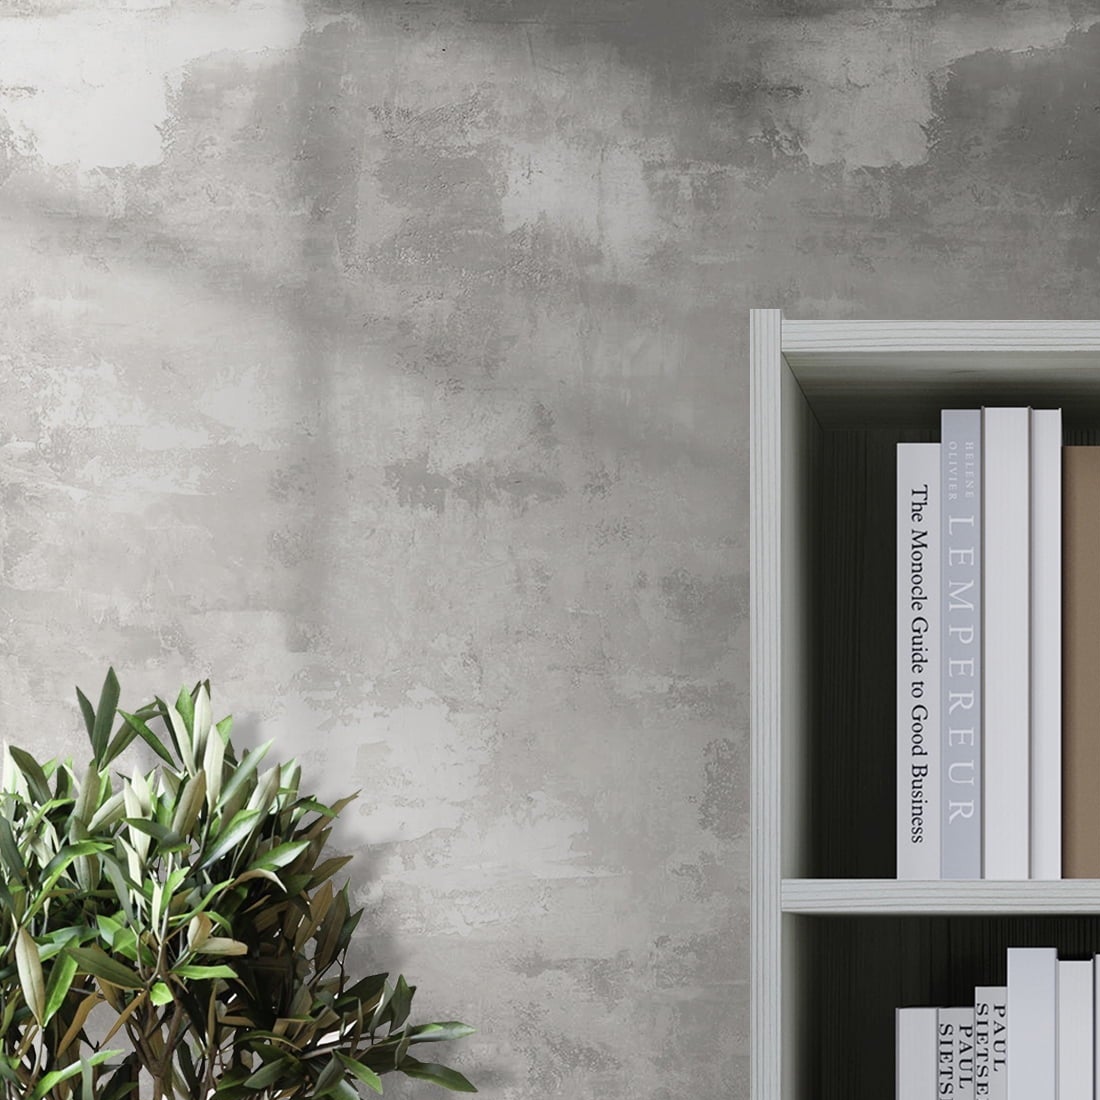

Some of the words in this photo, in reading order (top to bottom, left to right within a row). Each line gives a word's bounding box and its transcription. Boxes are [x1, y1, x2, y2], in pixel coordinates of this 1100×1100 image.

[949, 440, 958, 501] OLIVIER
[965, 441, 974, 499] HELENE
[911, 485, 928, 523] The
[910, 529, 928, 611] Monocle
[910, 617, 928, 674] Guide
[948, 515, 975, 824] LEMPEREUR
[911, 681, 927, 698] to
[910, 704, 928, 756] Good
[911, 764, 928, 844] Business
[959, 1024, 973, 1089] PAUL
[993, 1003, 1007, 1073] PAUL
